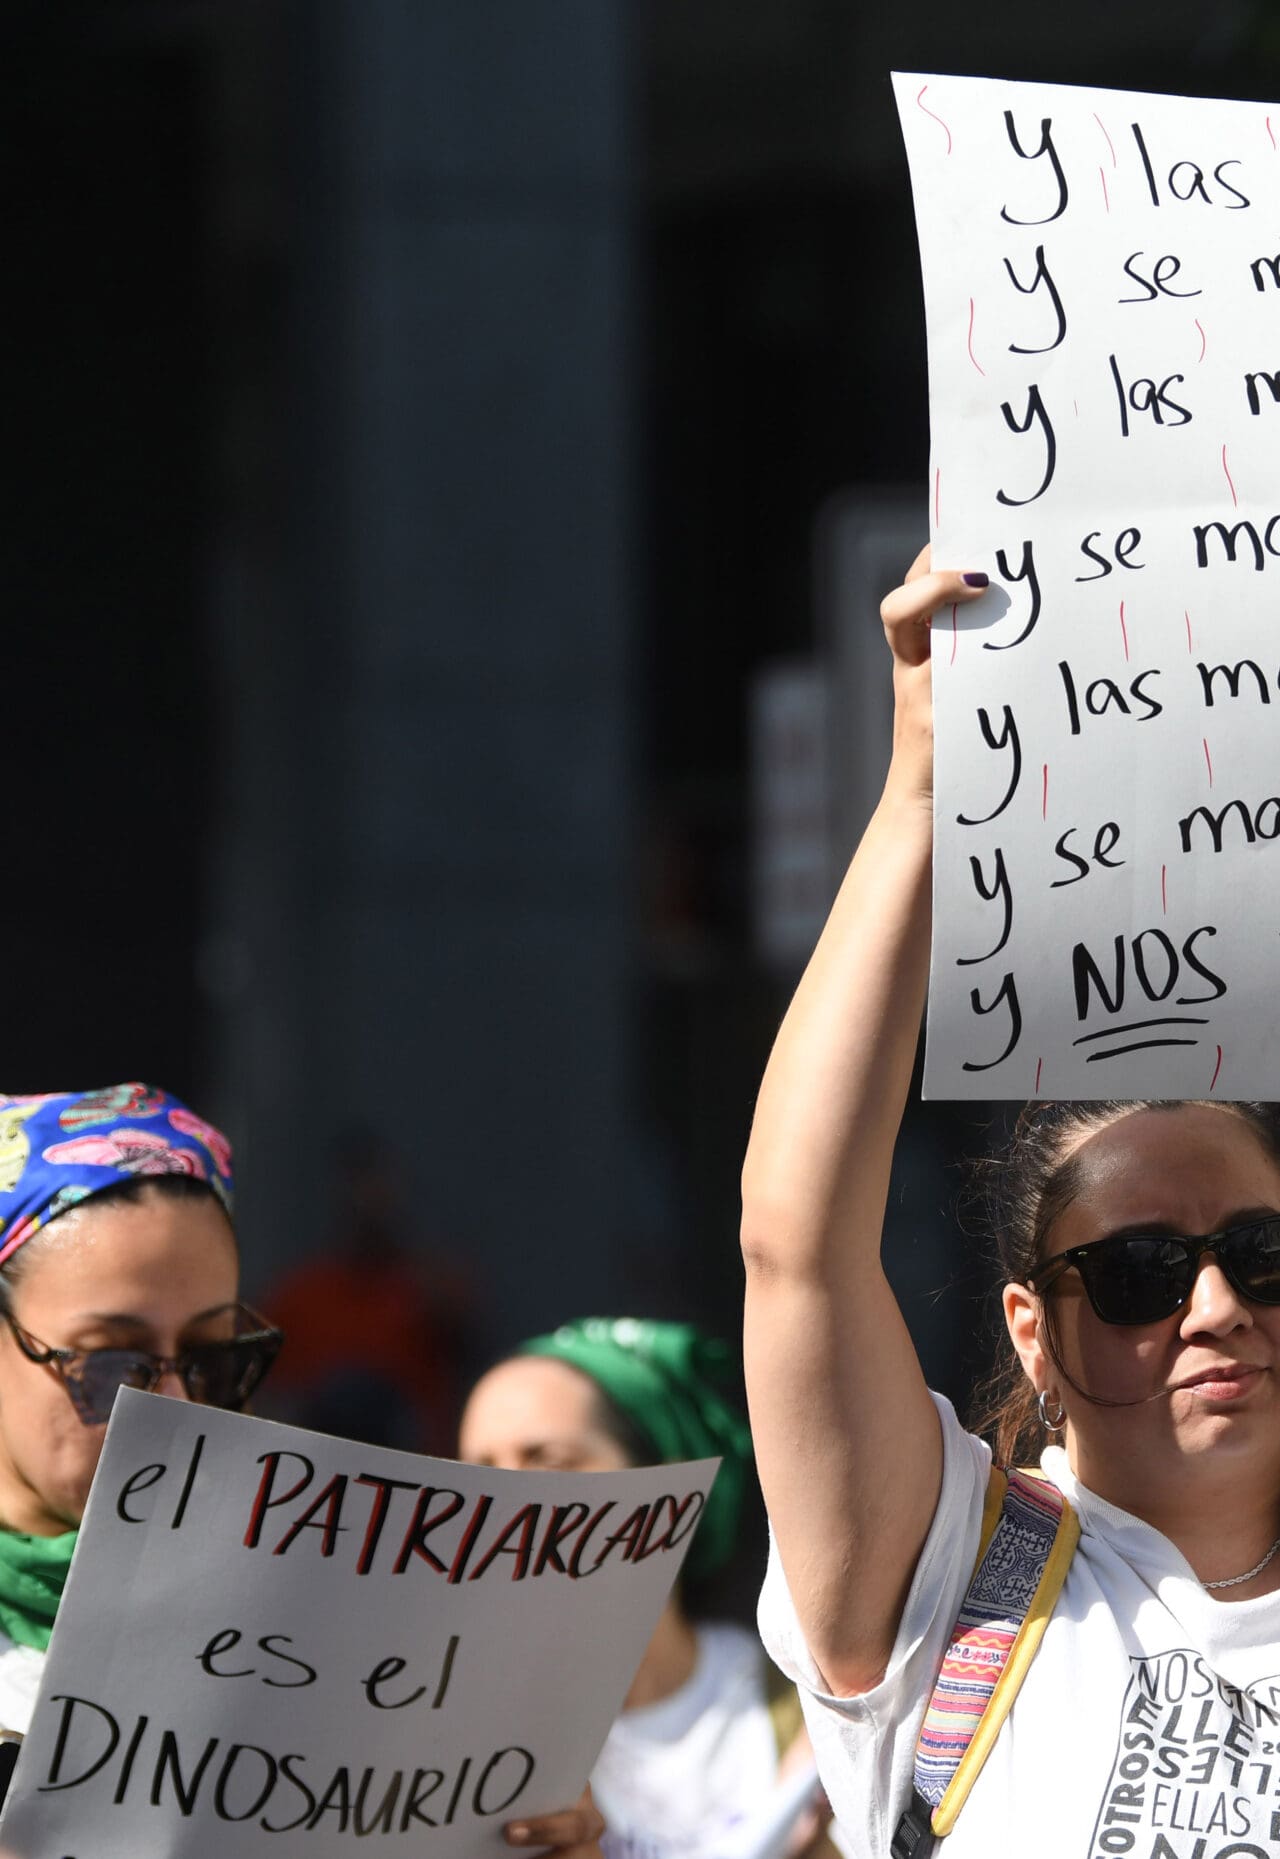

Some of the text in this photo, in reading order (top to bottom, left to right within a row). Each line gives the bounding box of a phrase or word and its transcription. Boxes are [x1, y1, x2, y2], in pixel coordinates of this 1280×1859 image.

[1131, 122, 1251, 209] las
[1118, 251, 1203, 304] se
[1109, 354, 1193, 437] las
[1075, 527, 1145, 582] se
[1058, 660, 1163, 735] las
[1050, 821, 1126, 889] se
[1072, 925, 1228, 1022] NOS
[116, 1434, 705, 1584] el PATRIARCADO
[195, 1629, 460, 1710] es el
[37, 1695, 536, 1837] DINOSAURIO
[1151, 1783, 1251, 1837] ELLAS
